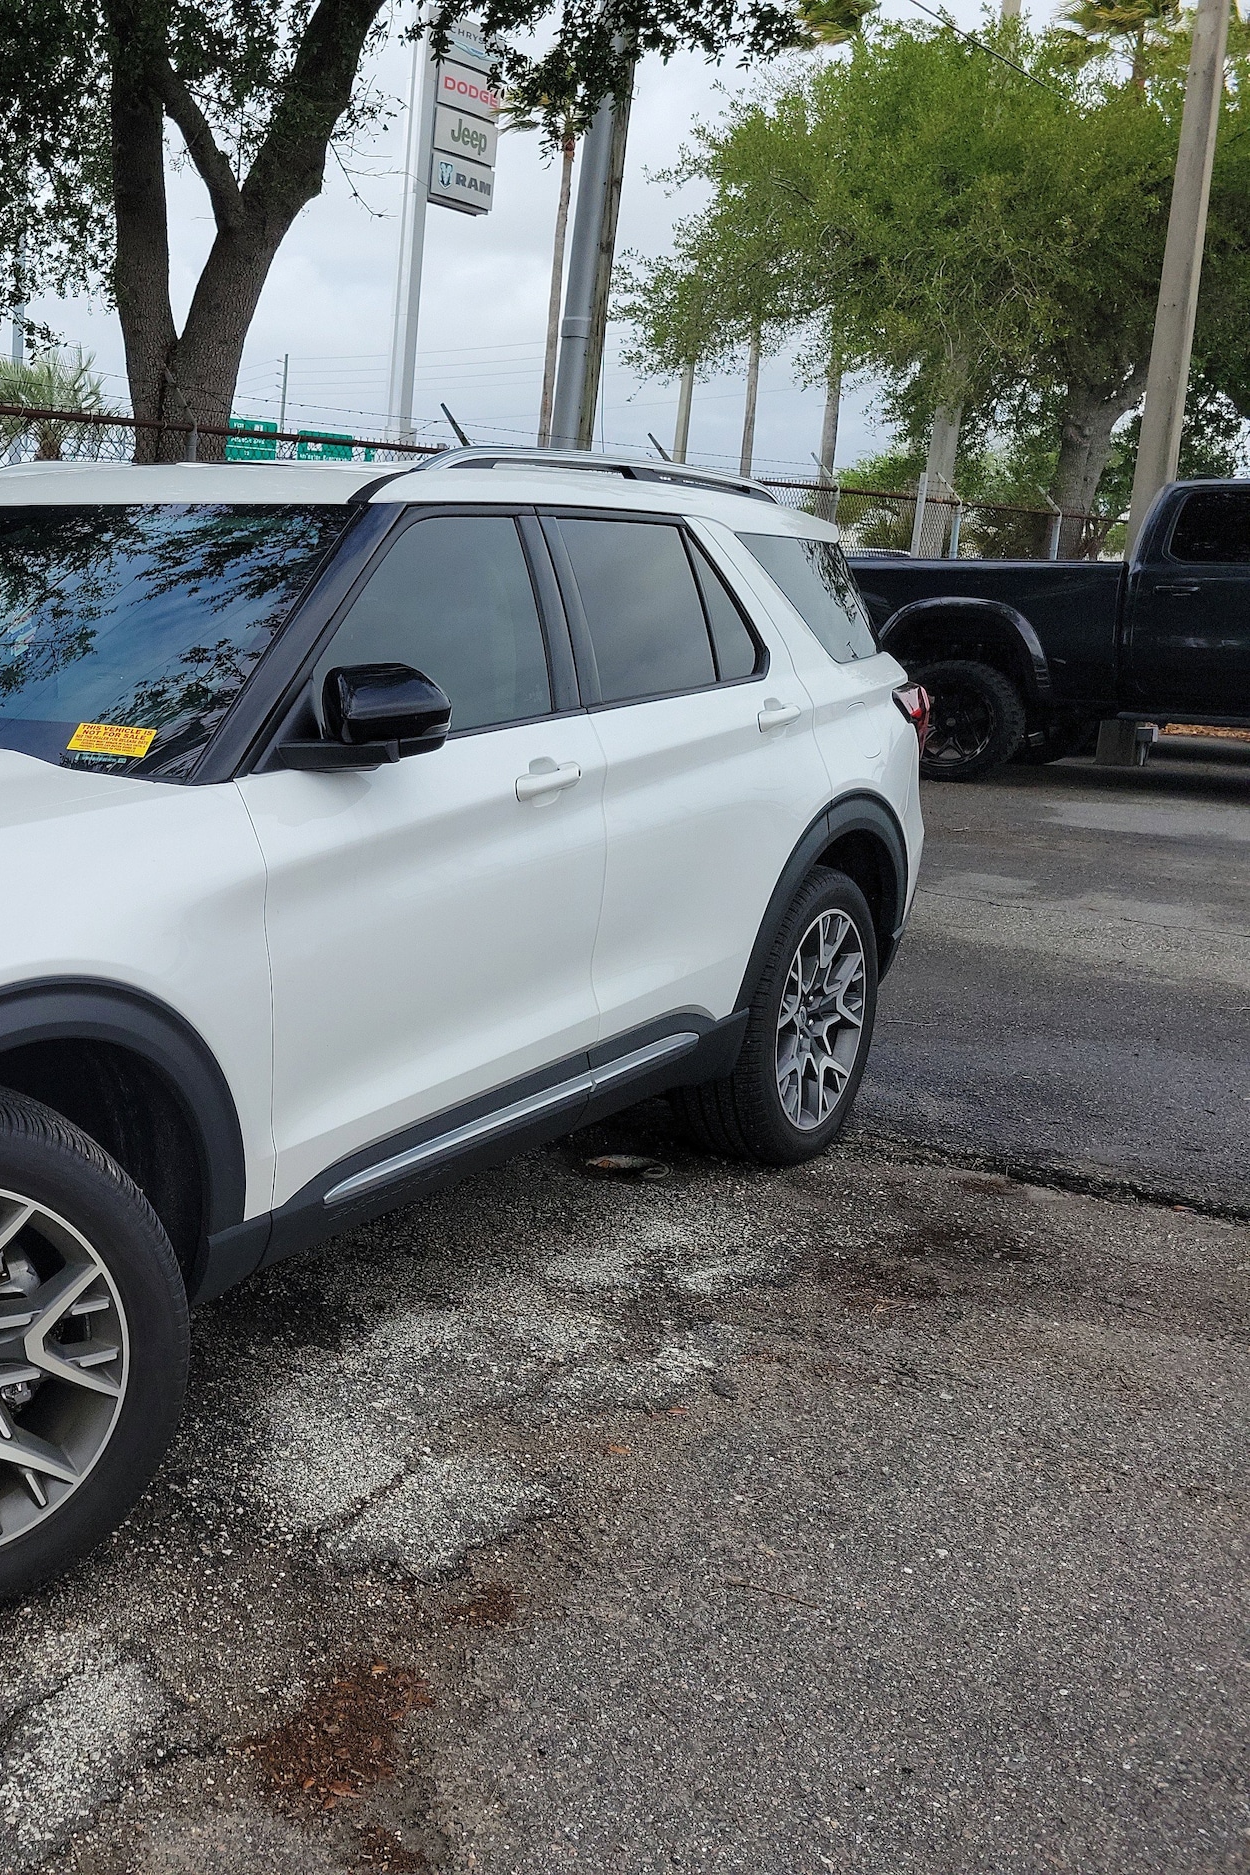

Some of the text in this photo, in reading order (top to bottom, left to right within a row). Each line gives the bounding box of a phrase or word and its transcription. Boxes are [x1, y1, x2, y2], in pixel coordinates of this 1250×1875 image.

[444, 76, 498, 108] DODGE
[451, 118, 487, 155] Jeep
[456, 172, 491, 196] RAM
